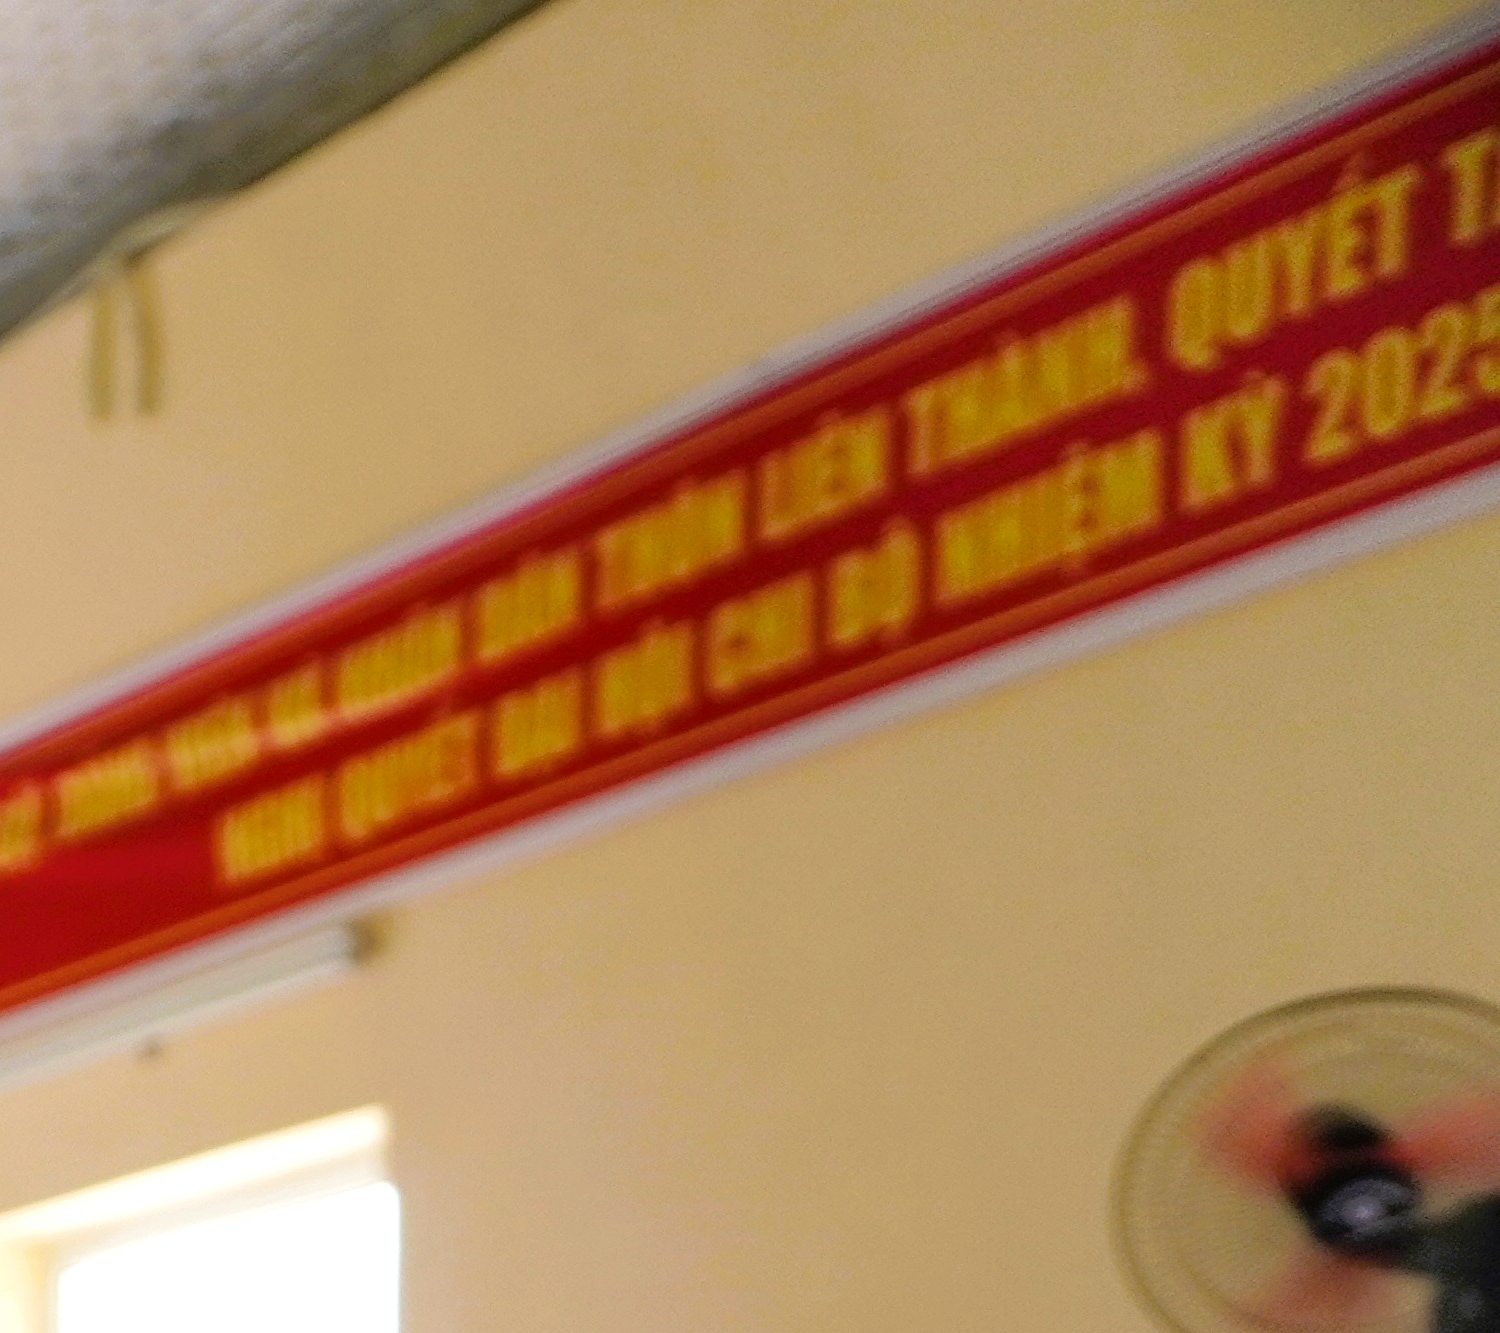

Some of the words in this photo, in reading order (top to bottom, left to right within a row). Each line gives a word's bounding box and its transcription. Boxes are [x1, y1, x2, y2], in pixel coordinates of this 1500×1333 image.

[1168, 152, 1422, 371] QUYẾT
[1441, 128, 1500, 248] T
[1178, 369, 1288, 511] KỲ
